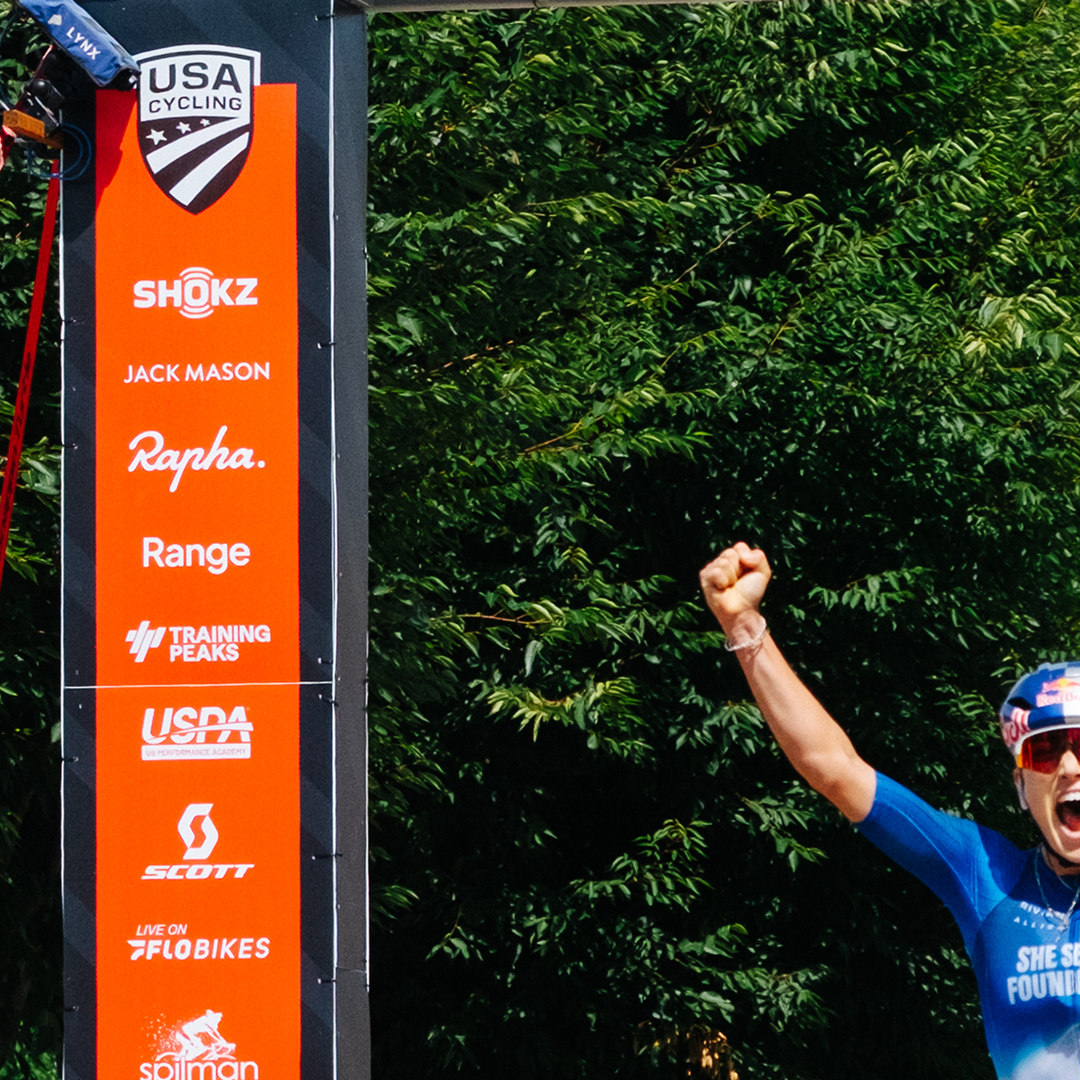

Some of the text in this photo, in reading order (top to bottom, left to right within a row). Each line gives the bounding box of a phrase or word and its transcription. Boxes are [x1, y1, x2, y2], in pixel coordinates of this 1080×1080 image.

[66, 26, 101, 61] LYNX
[149, 61, 243, 94] USA
[149, 96, 243, 114] CYCLING
[133, 277, 259, 308] SHOKZ
[123, 361, 270, 384] JACK MASON
[142, 536, 251, 575] Range
[168, 624, 271, 644] TRAINING
[169, 642, 240, 663] PEAKS
[141, 705, 254, 745] USPA
[140, 863, 255, 881] SCOTT
[135, 923, 188, 937] LIVE ON
[145, 937, 271, 961] FLOBIKES
[1016, 945, 1057, 973] SHE
